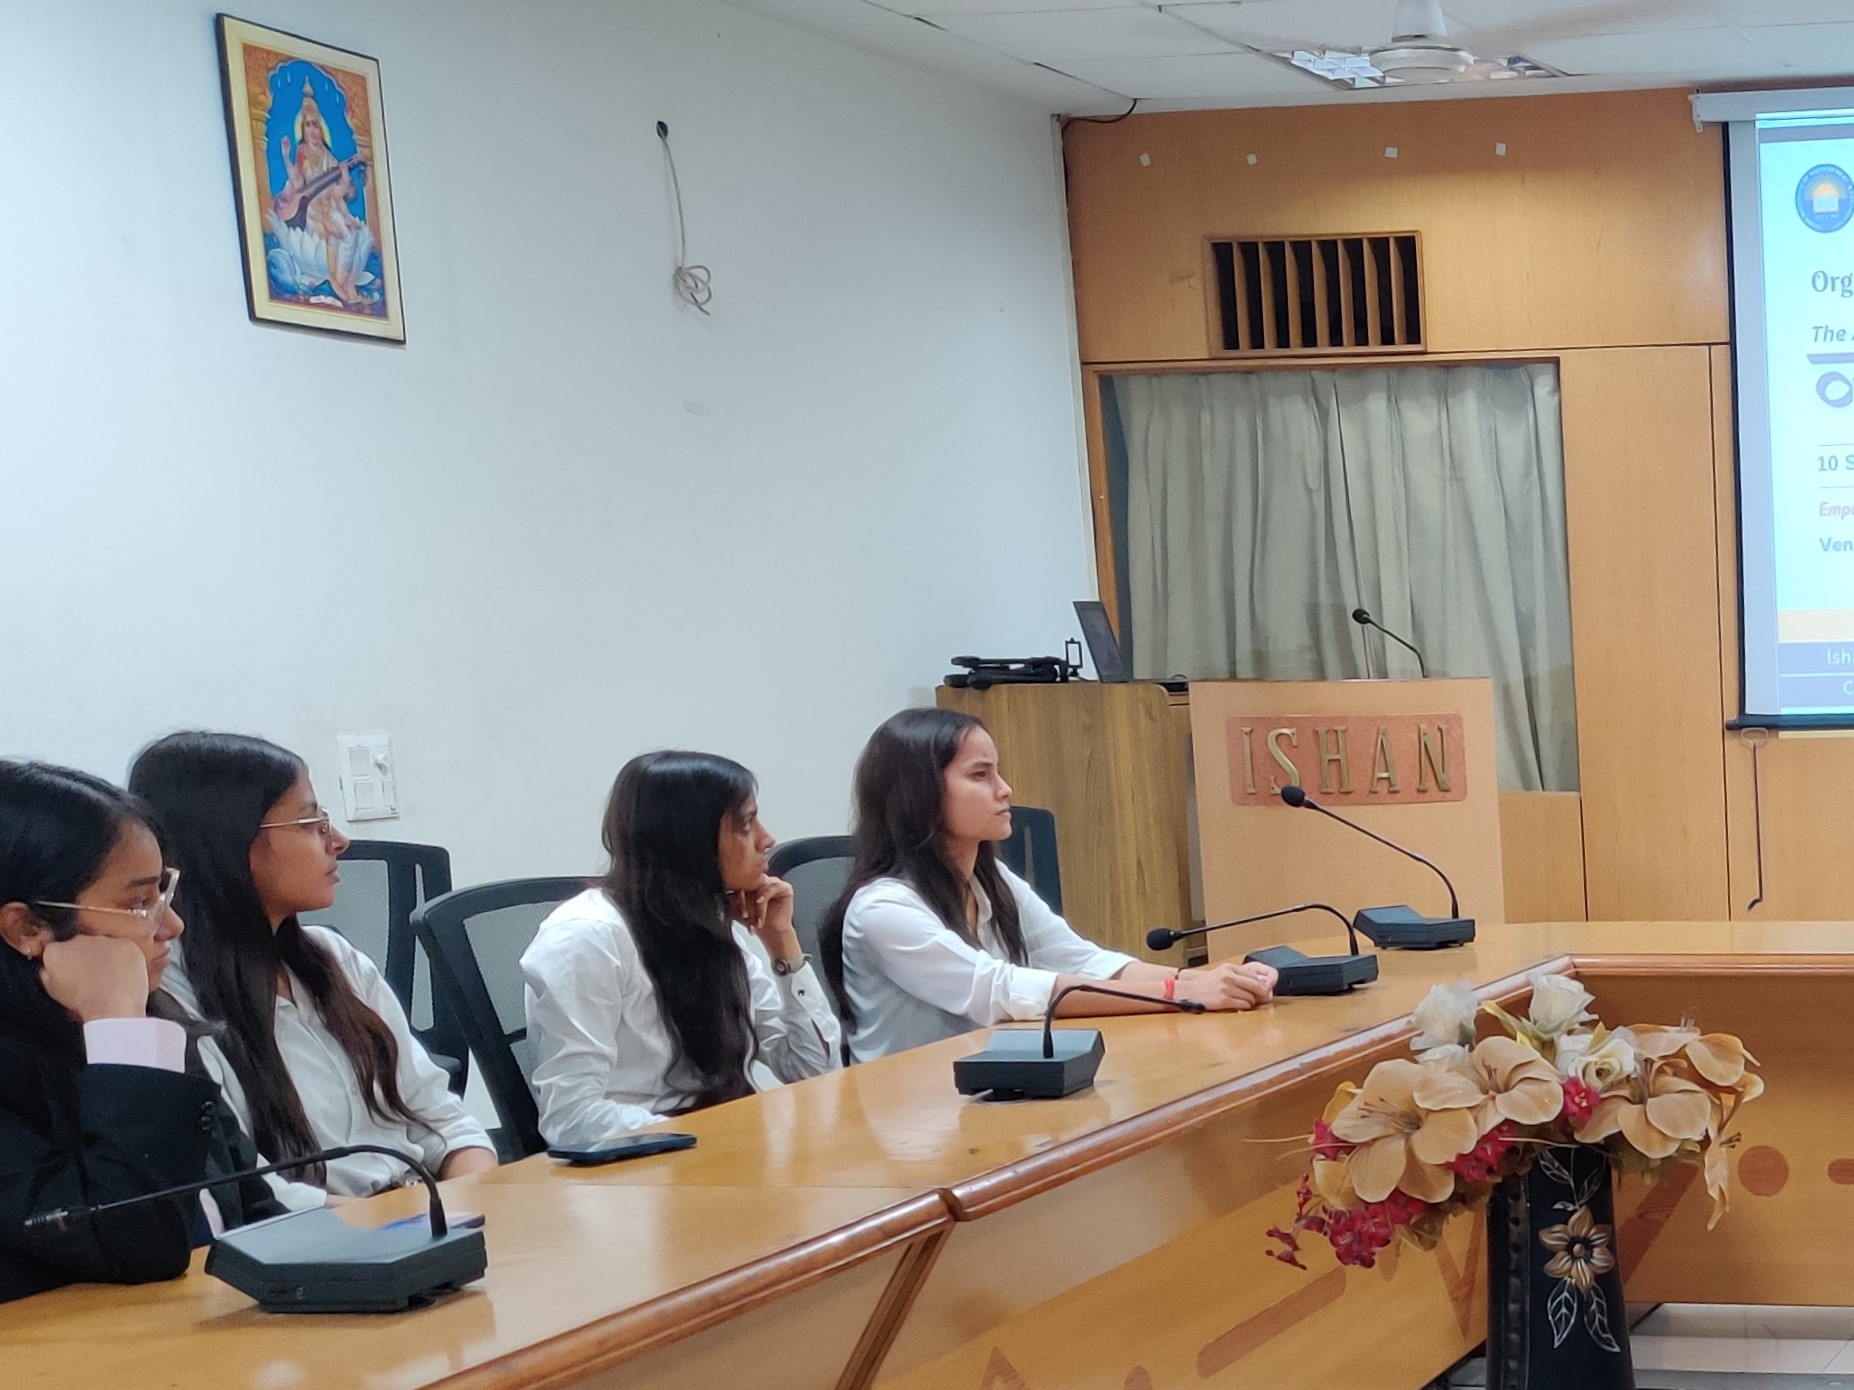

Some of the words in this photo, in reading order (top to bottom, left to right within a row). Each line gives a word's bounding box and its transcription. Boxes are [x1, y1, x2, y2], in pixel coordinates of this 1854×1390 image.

[1811, 325, 1846, 343] The
[1817, 454, 1838, 472] 10
[1240, 724, 1452, 794] ISHAN
